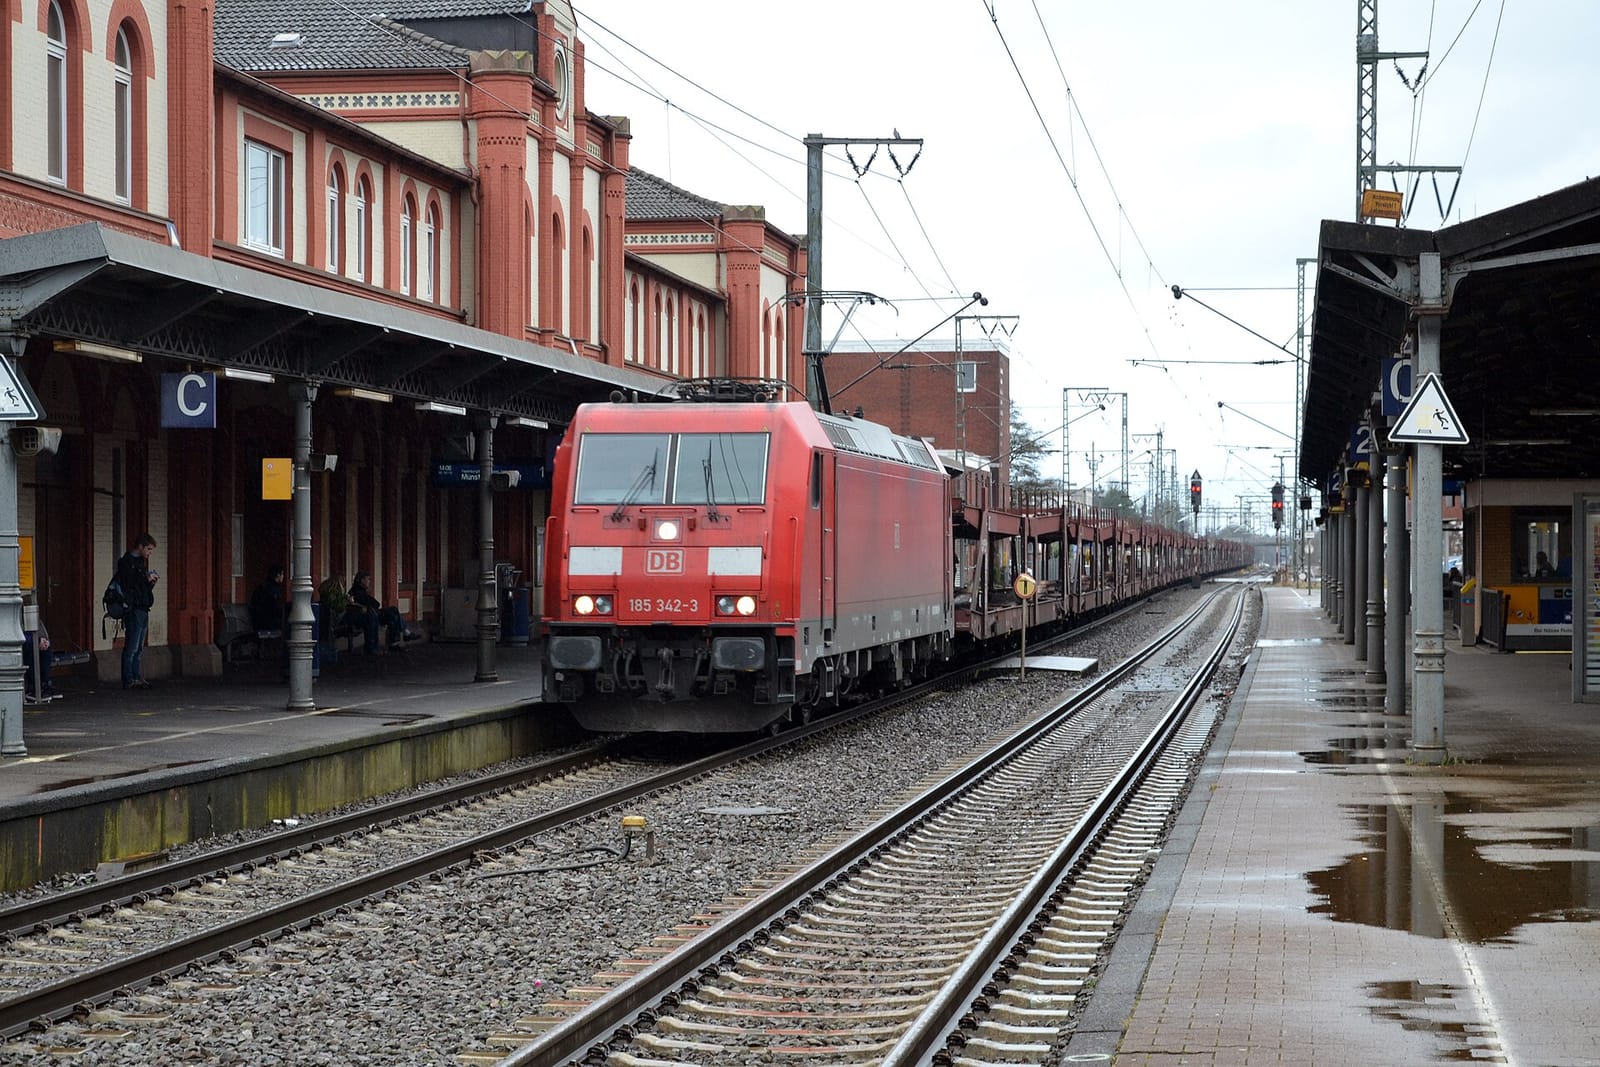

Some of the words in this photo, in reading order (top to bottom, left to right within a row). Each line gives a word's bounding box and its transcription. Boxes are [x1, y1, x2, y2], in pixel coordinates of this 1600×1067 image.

[177, 374, 207, 417] C
[1355, 425, 1369, 454] 2
[538, 465, 545, 479] 1
[1332, 472, 1340, 491] 2
[1305, 519, 1314, 531] H
[649, 551, 681, 571] DB
[629, 598, 652, 612] 185
[656, 598, 699, 612] 342-3
